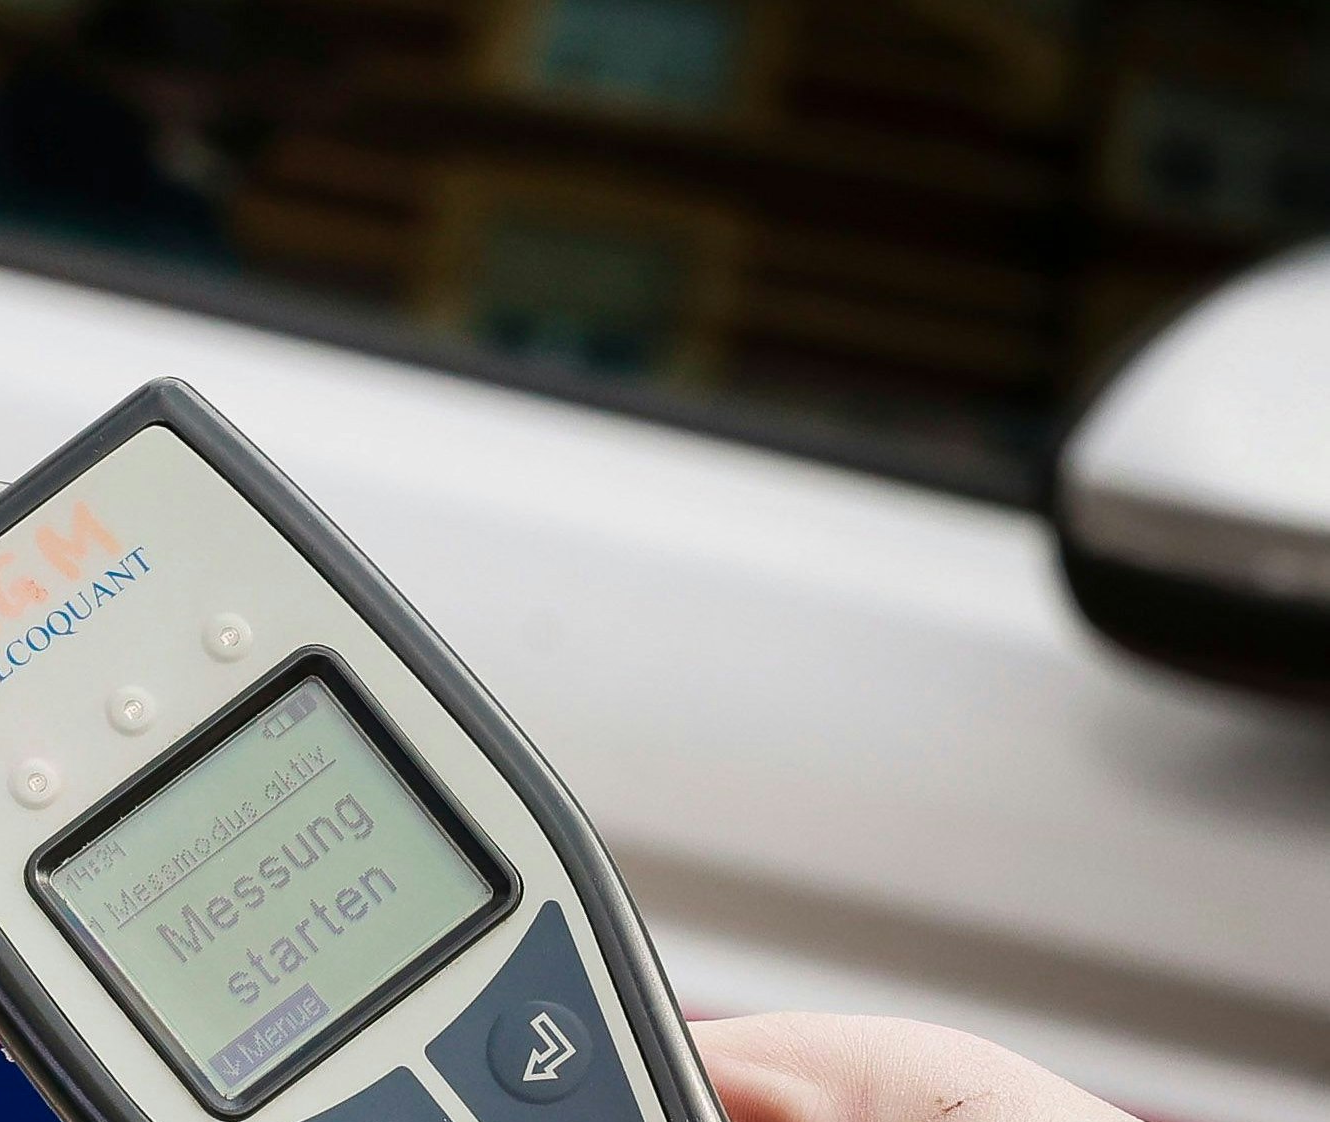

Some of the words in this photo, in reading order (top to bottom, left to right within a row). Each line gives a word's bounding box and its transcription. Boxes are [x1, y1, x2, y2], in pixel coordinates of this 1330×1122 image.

[103, 801, 258, 923] Messmodus
[264, 745, 326, 801] aktiv
[155, 792, 376, 964] Messung
[227, 864, 398, 1005] starten
[236, 997, 322, 1066] Menue
